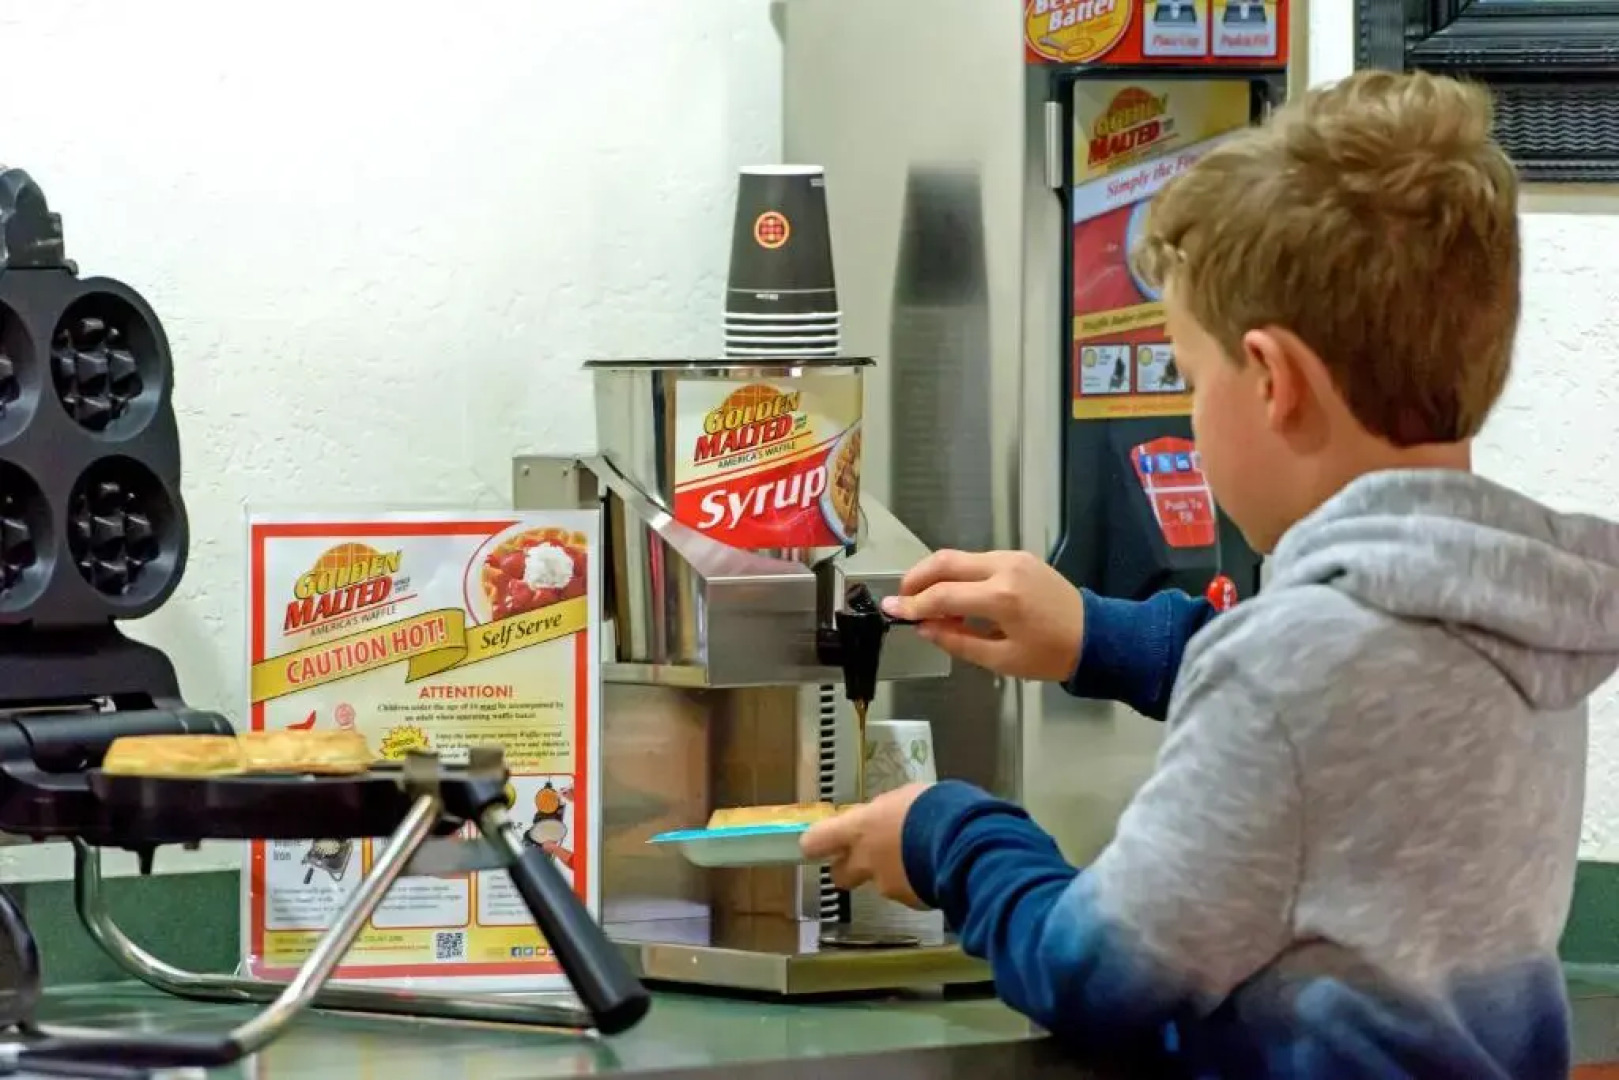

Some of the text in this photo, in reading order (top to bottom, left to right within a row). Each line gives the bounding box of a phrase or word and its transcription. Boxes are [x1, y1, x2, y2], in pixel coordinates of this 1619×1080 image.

[1088, 120, 1160, 166] MALTED
[703, 392, 801, 435] GOLDEN
[694, 414, 793, 462] MALTED
[717, 449, 763, 469] AMERICA'S
[697, 466, 826, 529] Syrup
[294, 549, 403, 600] GOLDEN
[284, 576, 393, 632] MALTED
[310, 603, 397, 638] AMERICA'S WAFFLE
[286, 617, 448, 684] CAUTION HOT!
[480, 611, 563, 650] Self Serve
[418, 685, 514, 700] ATTENTION!
